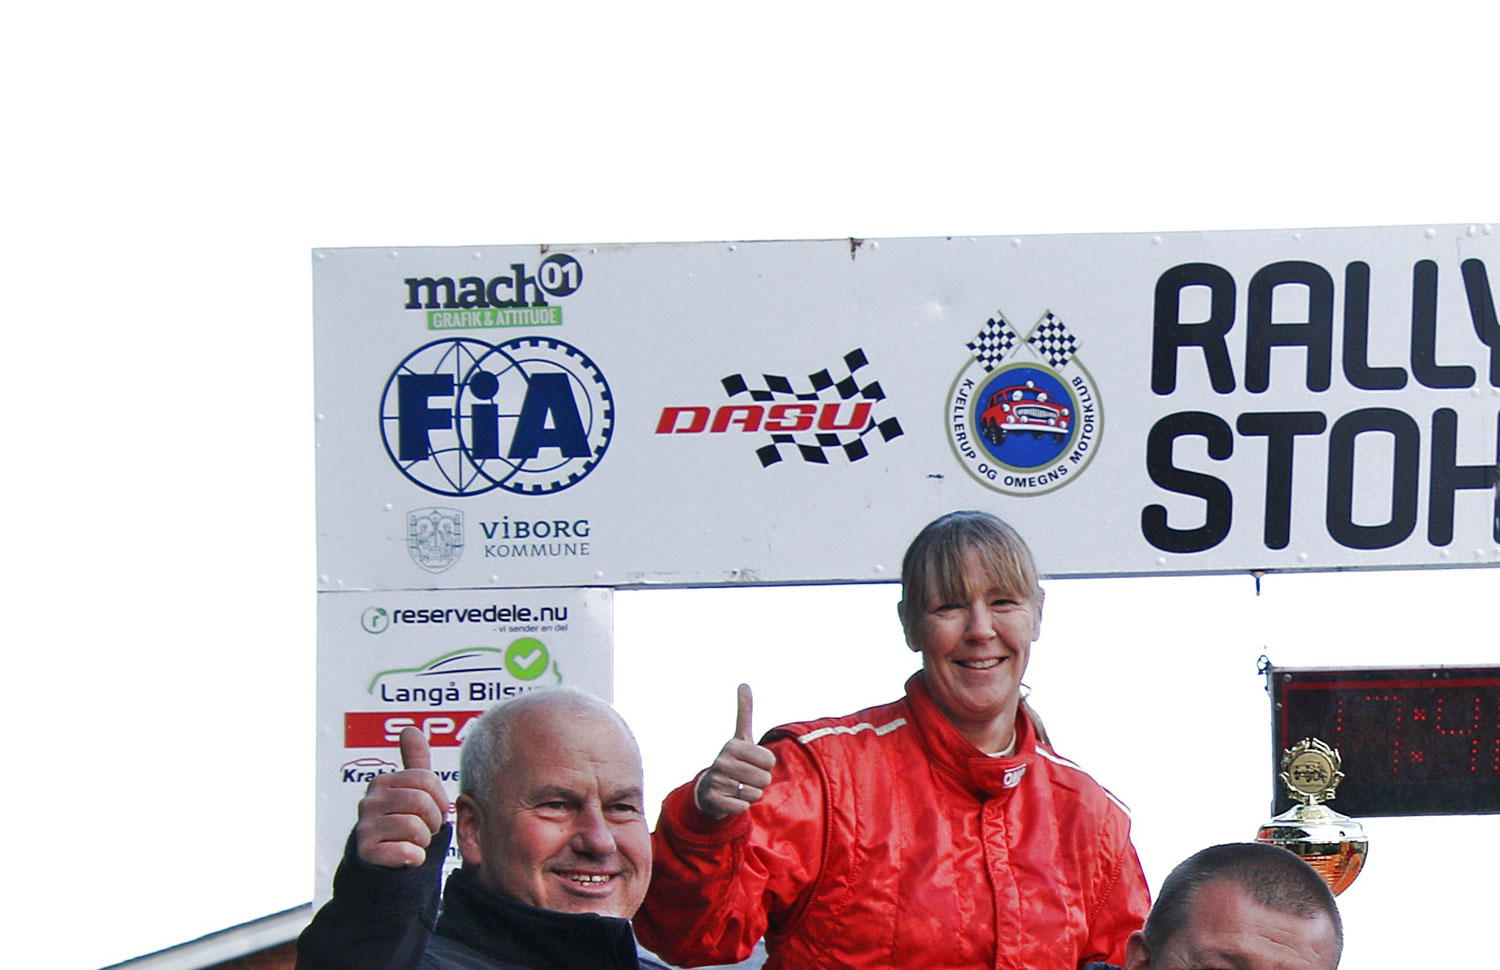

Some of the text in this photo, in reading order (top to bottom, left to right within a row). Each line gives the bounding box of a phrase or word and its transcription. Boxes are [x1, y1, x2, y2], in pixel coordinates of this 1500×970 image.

[404, 263, 548, 309] mach
[433, 309, 481, 328] GRAFIK
[495, 307, 557, 326] ATTITUDE
[654, 402, 874, 434] DASU
[953, 375, 1095, 488] KJELLERUP OG OMEGNS MOTORKLUB
[484, 542, 590, 559] KOMMUNE
[393, 604, 568, 624] reservedele.nu
[509, 624, 538, 633] sender
[381, 681, 460, 706] Langå
